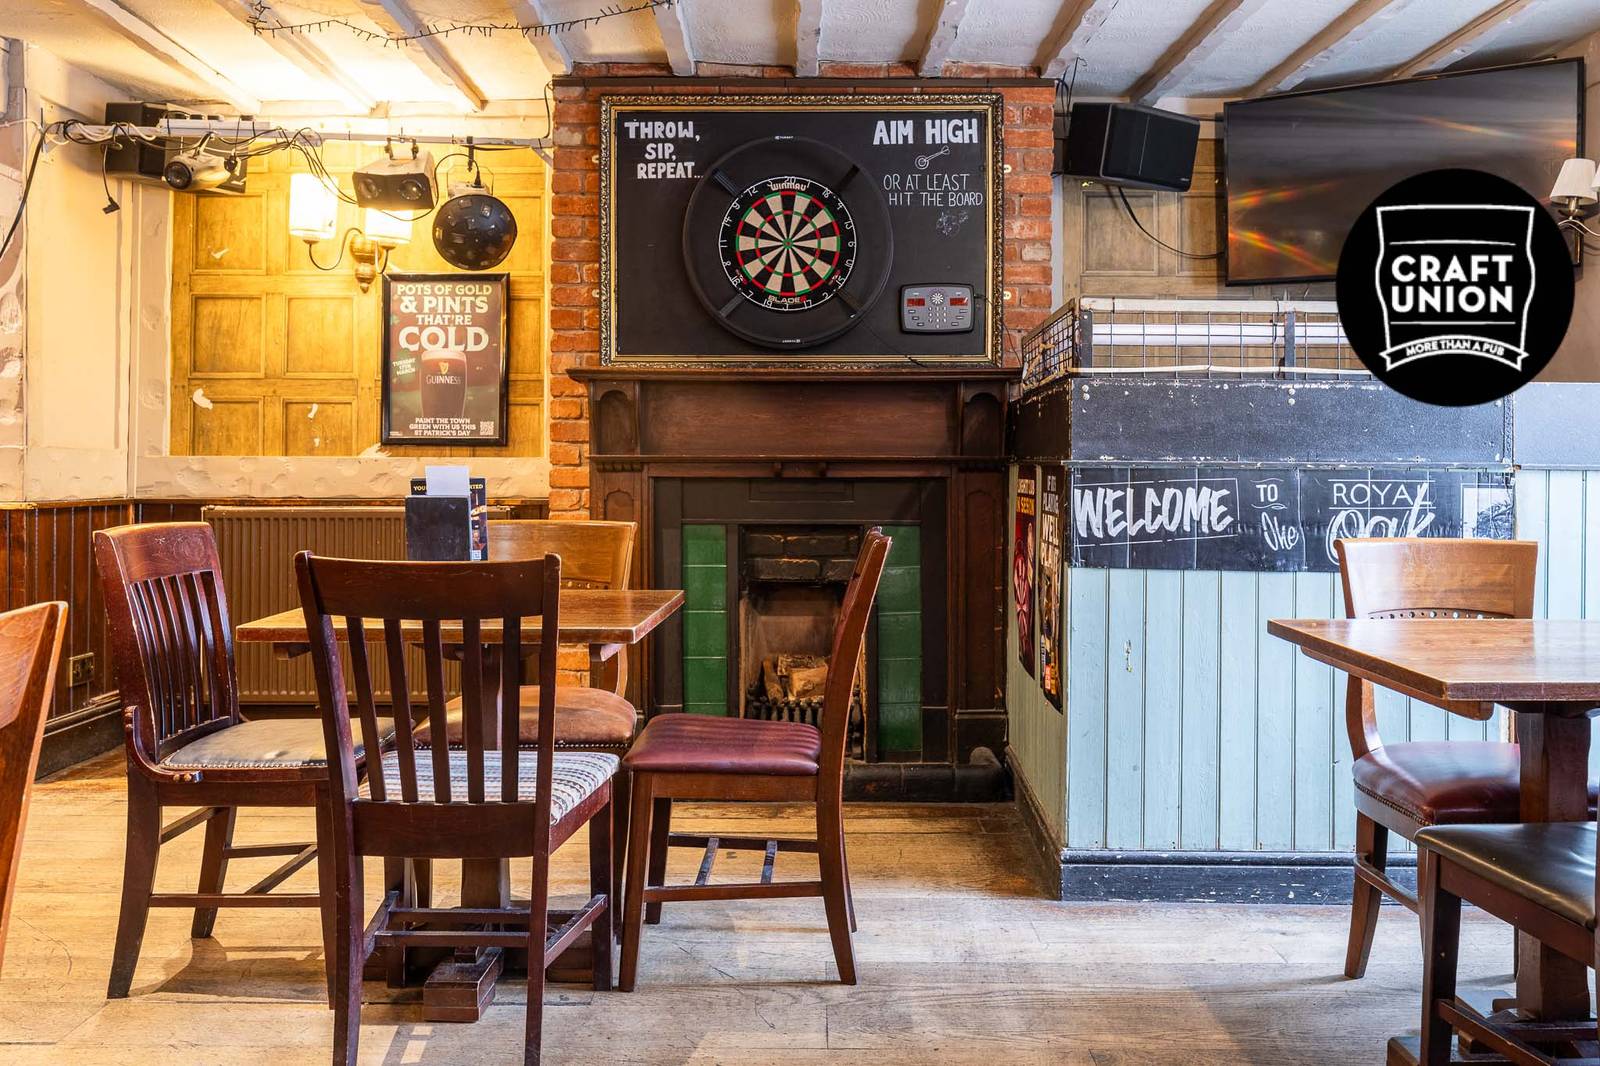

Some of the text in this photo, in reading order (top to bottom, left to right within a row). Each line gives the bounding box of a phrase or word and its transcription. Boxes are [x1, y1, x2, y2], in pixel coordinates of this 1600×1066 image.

[624, 120, 700, 142] THROW,
[873, 118, 979, 145] AIM HIGH
[644, 143, 677, 161] SIP,
[637, 161, 704, 179] REPEAT...
[883, 173, 970, 191] OR AT LEAST
[889, 191, 983, 206] HIT THE BOARD
[397, 284, 492, 295] POTS OF GOLD
[400, 296, 489, 313] & PINTS
[416, 314, 472, 325] THAT'RE
[398, 326, 489, 351] COLD
[1256, 484, 1279, 502] TO
[1333, 483, 1432, 505] ROYAL
[1074, 486, 1234, 538] WELCOME
